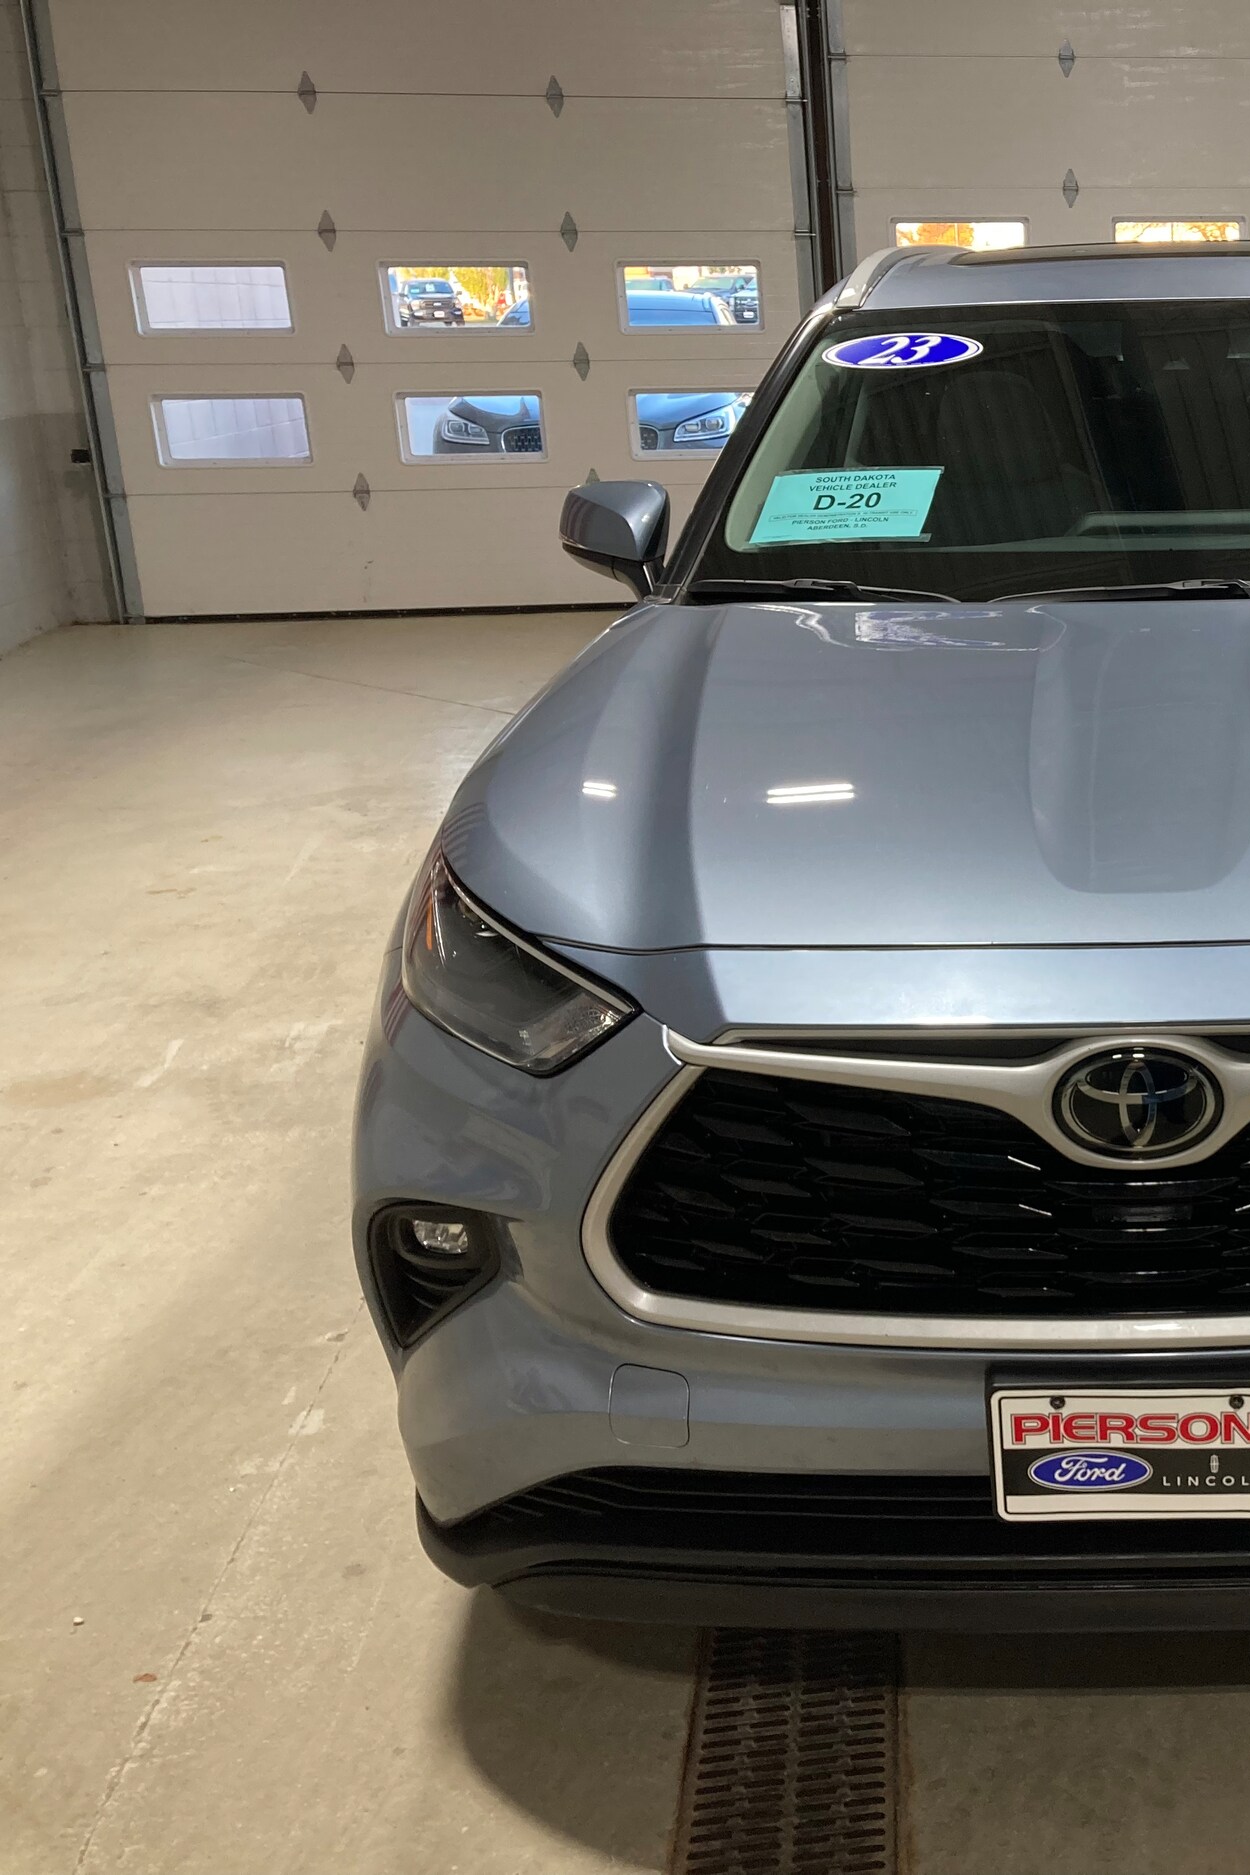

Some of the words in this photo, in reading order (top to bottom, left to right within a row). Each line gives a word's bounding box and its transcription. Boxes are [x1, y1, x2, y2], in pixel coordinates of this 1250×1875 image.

[857, 336, 942, 364] 23
[809, 484, 853, 492] VEHICLE
[855, 482, 897, 490] DEALER
[853, 474, 896, 482] DAKOTA
[813, 492, 881, 510] D-20
[1054, 1453, 1126, 1482] Ford
